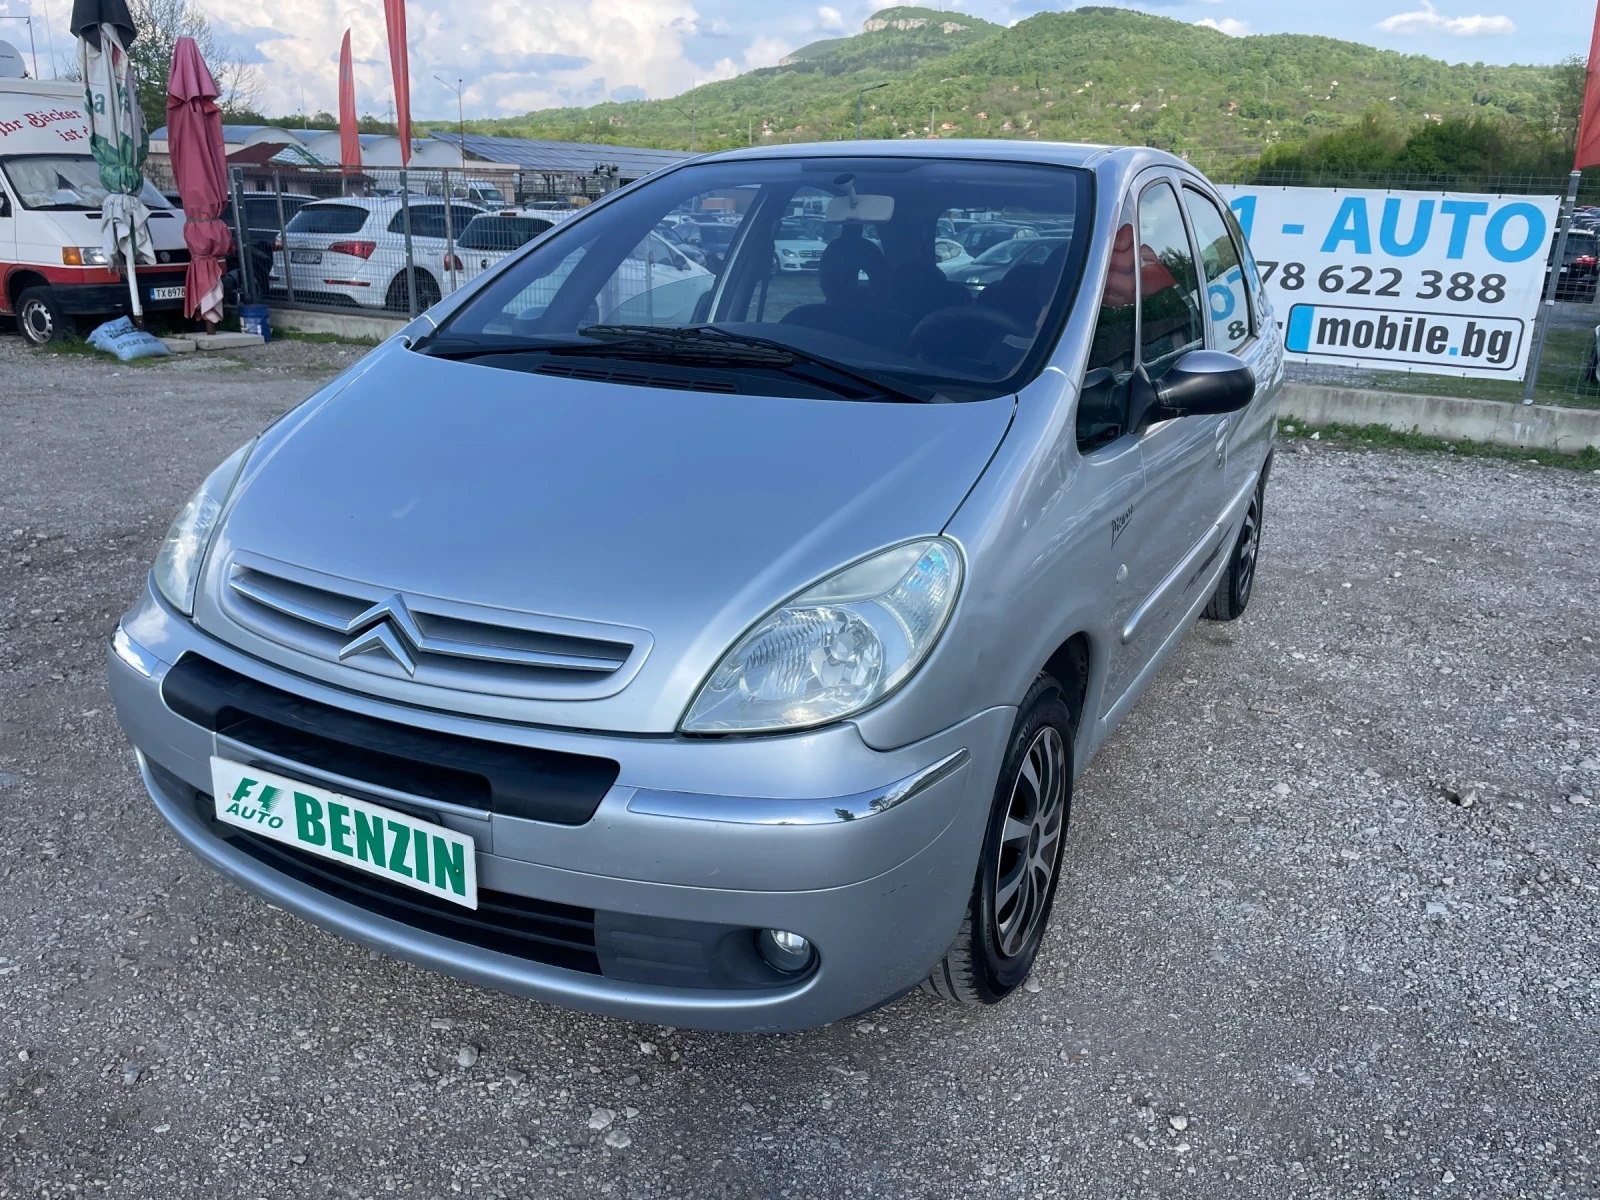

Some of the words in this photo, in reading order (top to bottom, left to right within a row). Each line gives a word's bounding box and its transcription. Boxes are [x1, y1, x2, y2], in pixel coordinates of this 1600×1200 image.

[23, 109, 82, 128] Bäcker
[1320, 196, 1547, 264] AUTO
[1318, 264, 1403, 297] 622
[1416, 269, 1507, 303] 388
[1316, 315, 1512, 363] mobile.bg
[225, 802, 284, 829] AUTO
[293, 791, 466, 897] BENZIN
